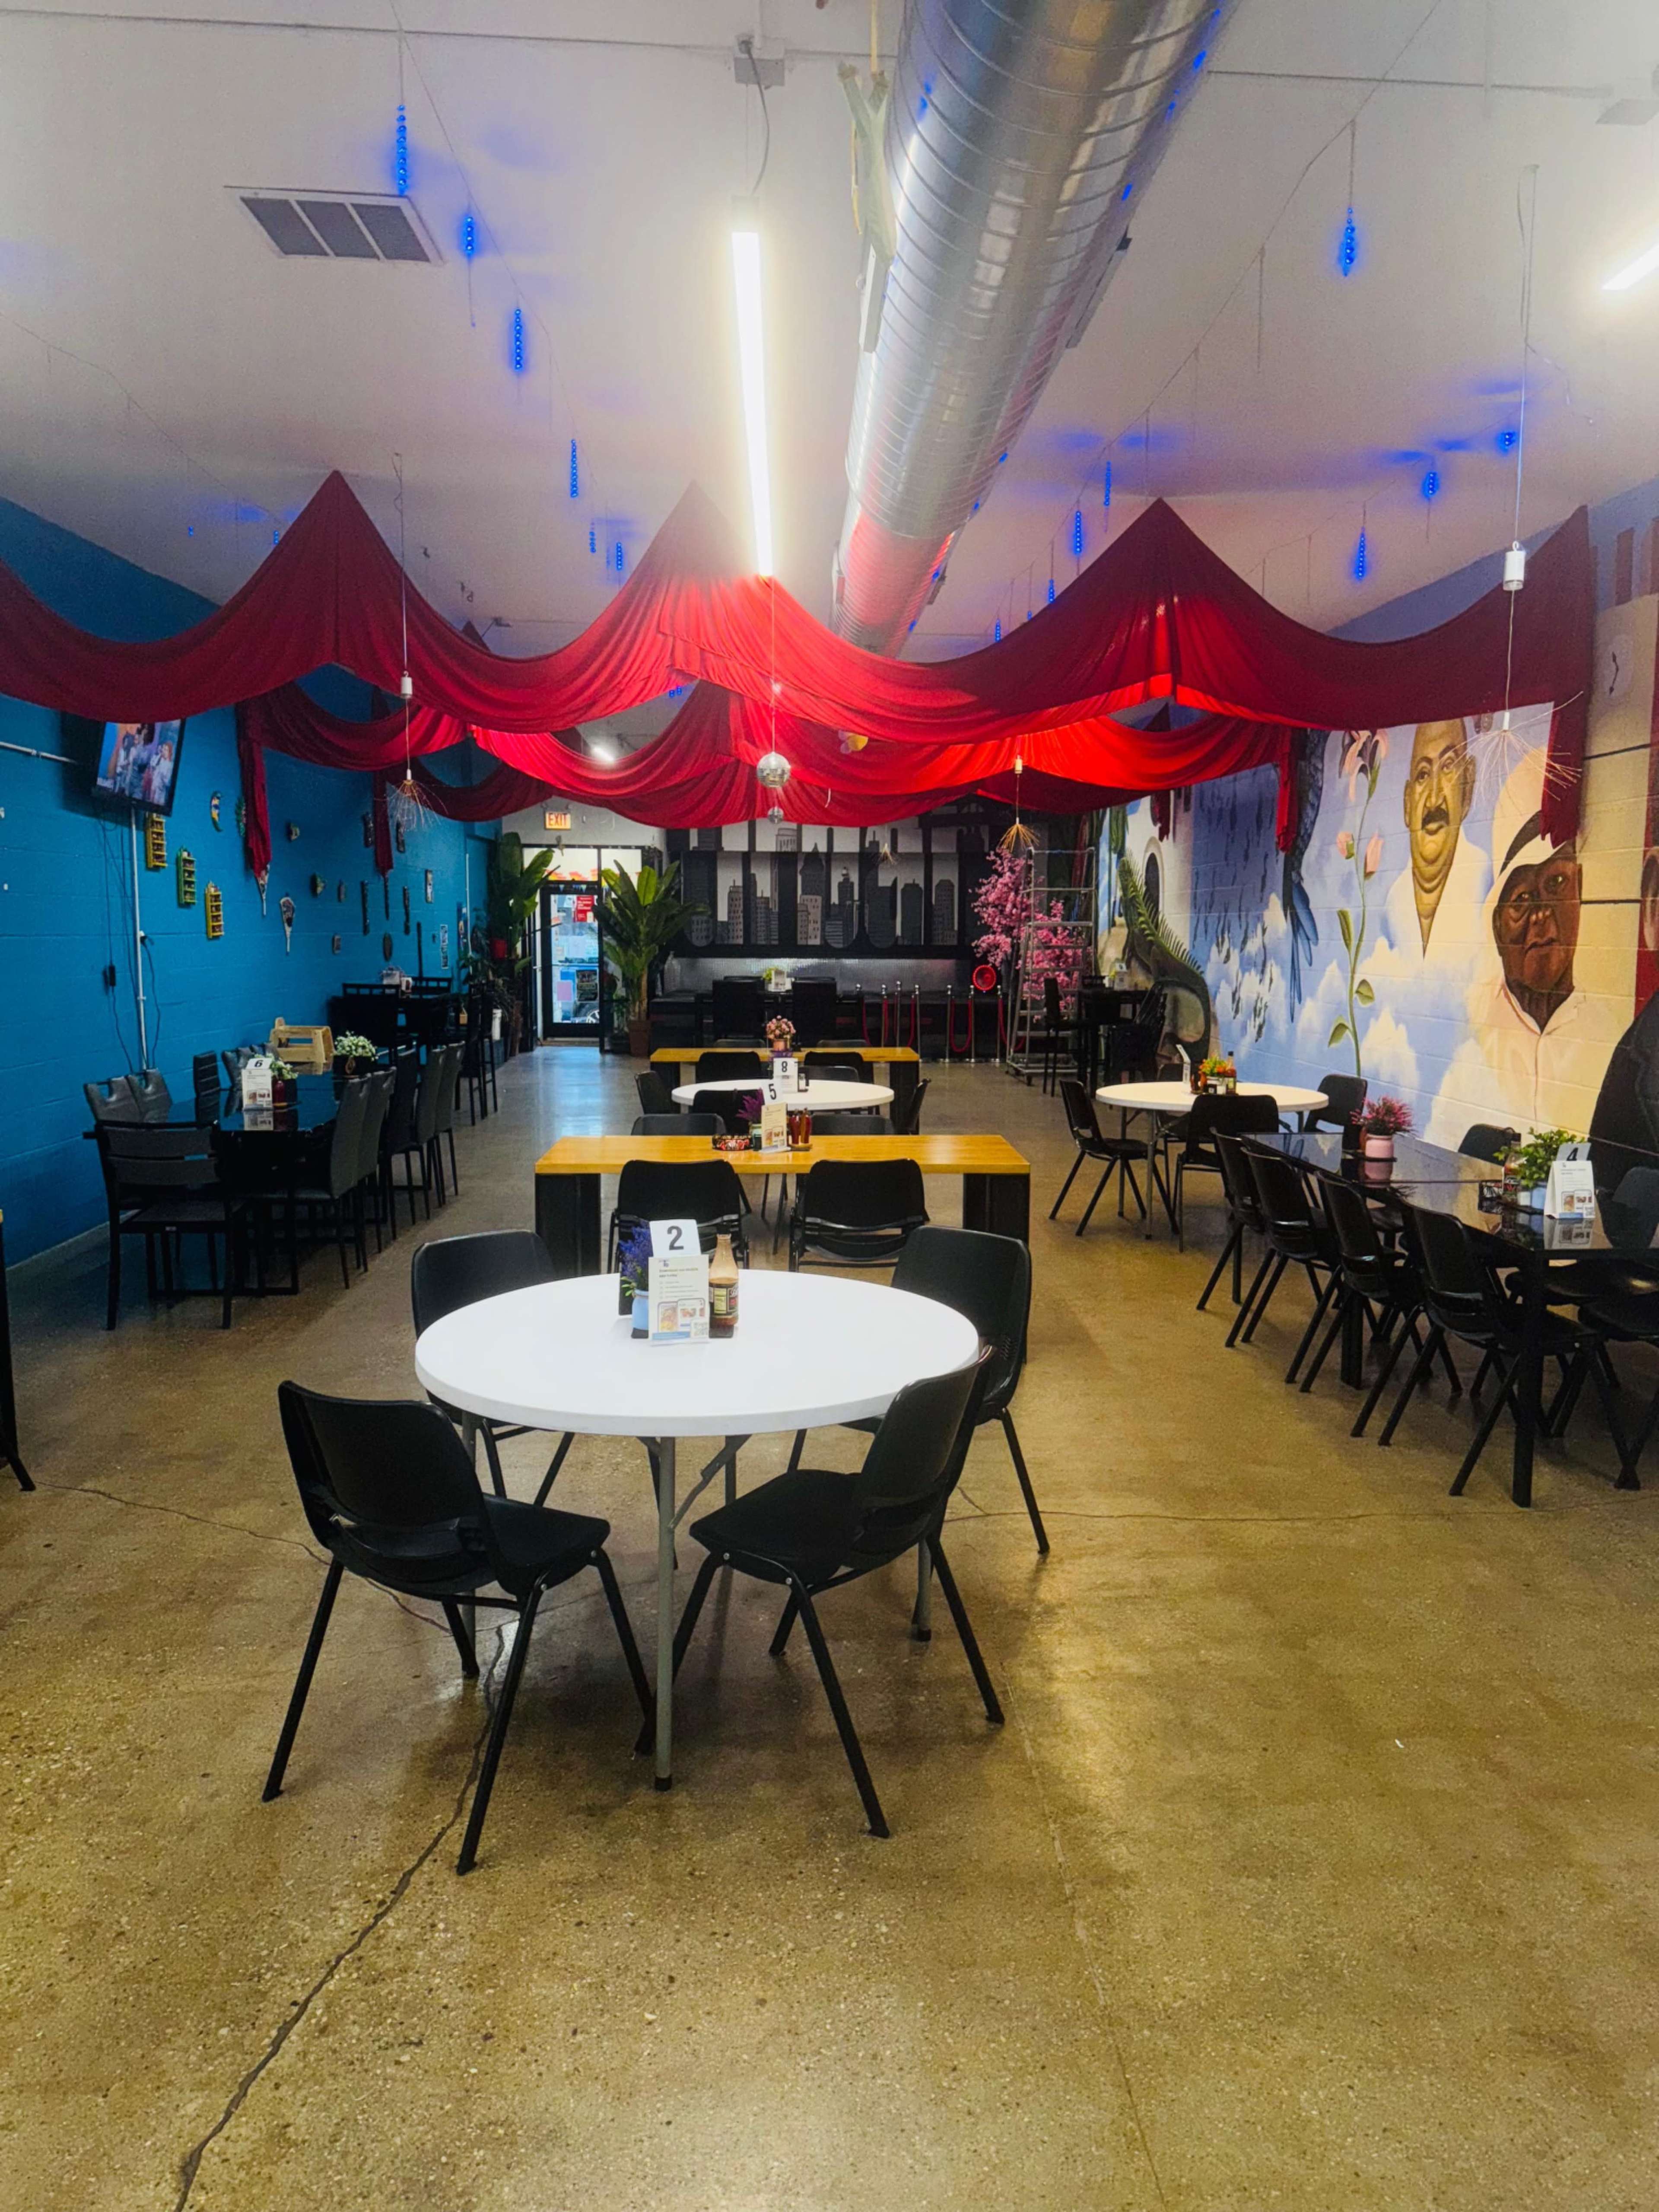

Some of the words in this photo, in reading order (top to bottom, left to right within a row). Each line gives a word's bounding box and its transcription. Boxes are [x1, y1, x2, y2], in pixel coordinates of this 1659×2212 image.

[548, 813, 567, 826] EXIT
[782, 1061, 788, 1072] 8
[769, 1084, 776, 1100] 5
[1567, 1147, 1579, 1161] 4
[667, 1226, 684, 1250] 2
